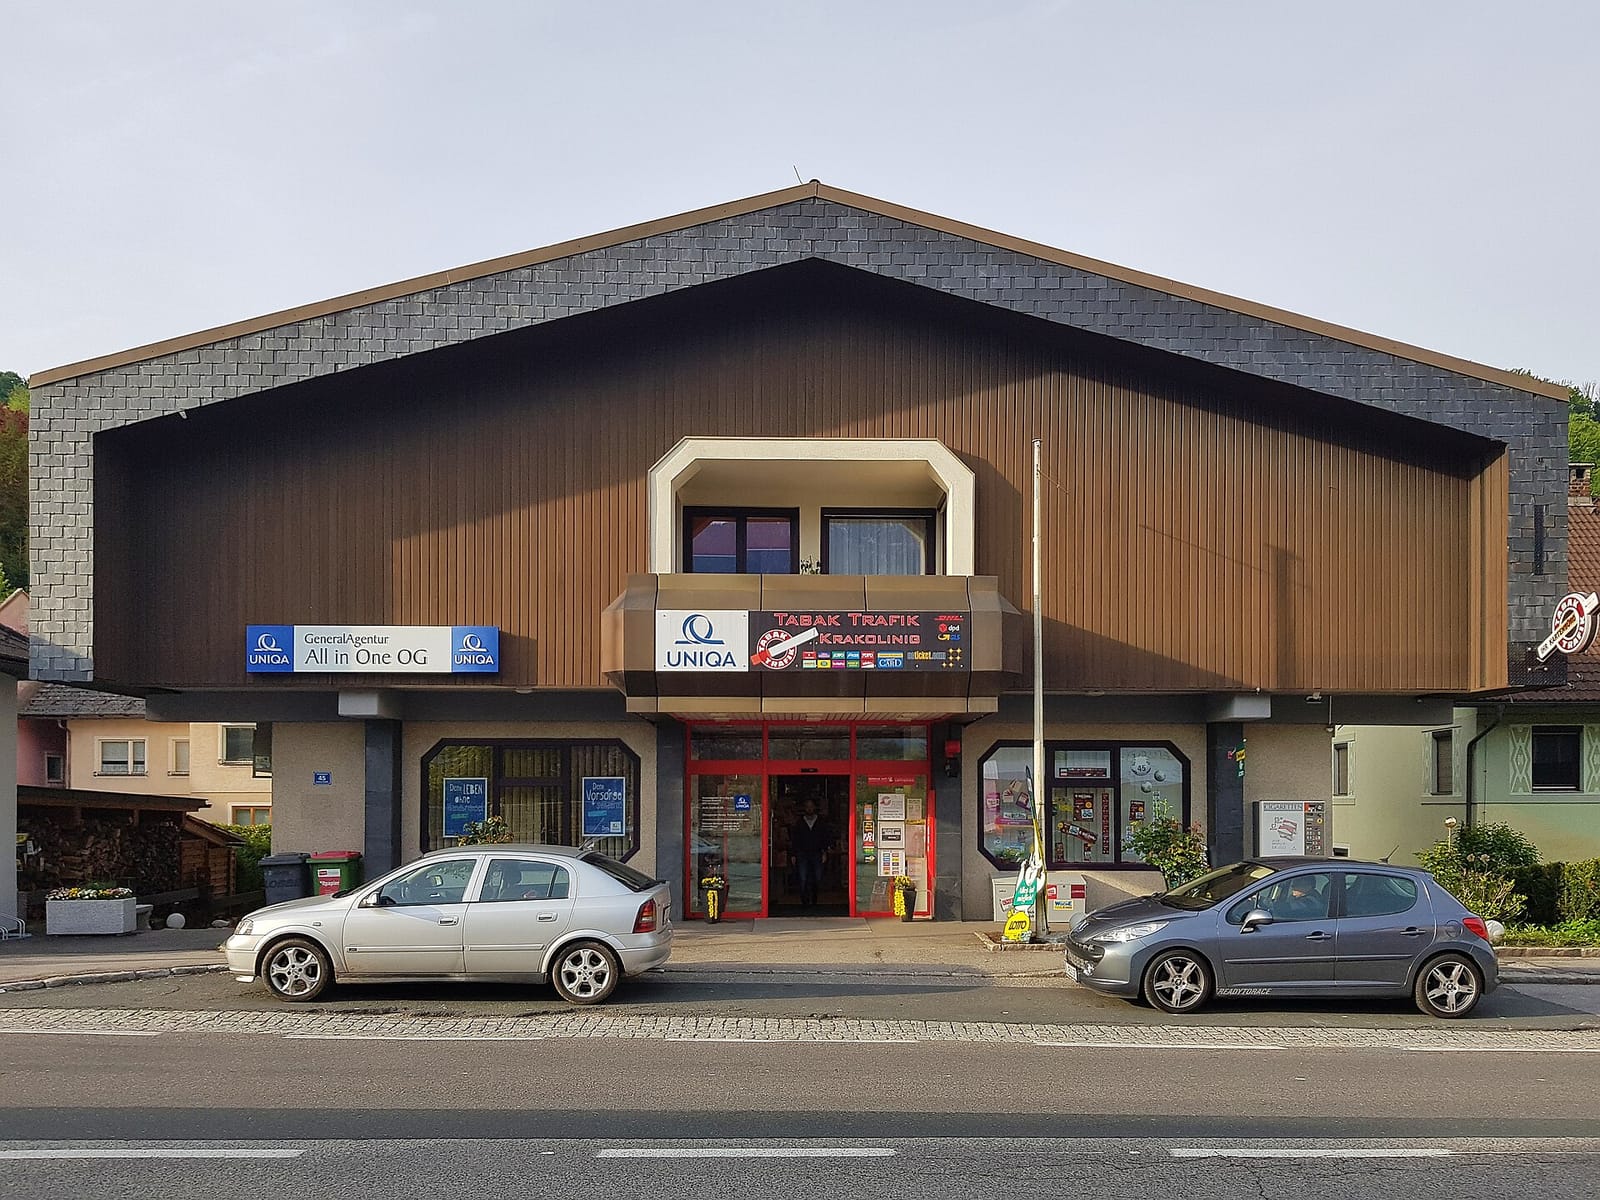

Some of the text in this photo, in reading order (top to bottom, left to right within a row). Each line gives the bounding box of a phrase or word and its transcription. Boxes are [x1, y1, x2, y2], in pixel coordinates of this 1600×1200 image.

[304, 633, 389, 647] GeneralAgentur
[758, 631, 788, 652] TABAK
[249, 655, 290, 665] UNIQA
[304, 649, 428, 665] All in One OG
[454, 655, 494, 665] UNIQA
[667, 651, 737, 667] UNIQA
[765, 648, 796, 668] TRAFIK
[463, 783, 483, 795] LEBEN
[1009, 920, 1027, 930] LOTTO
